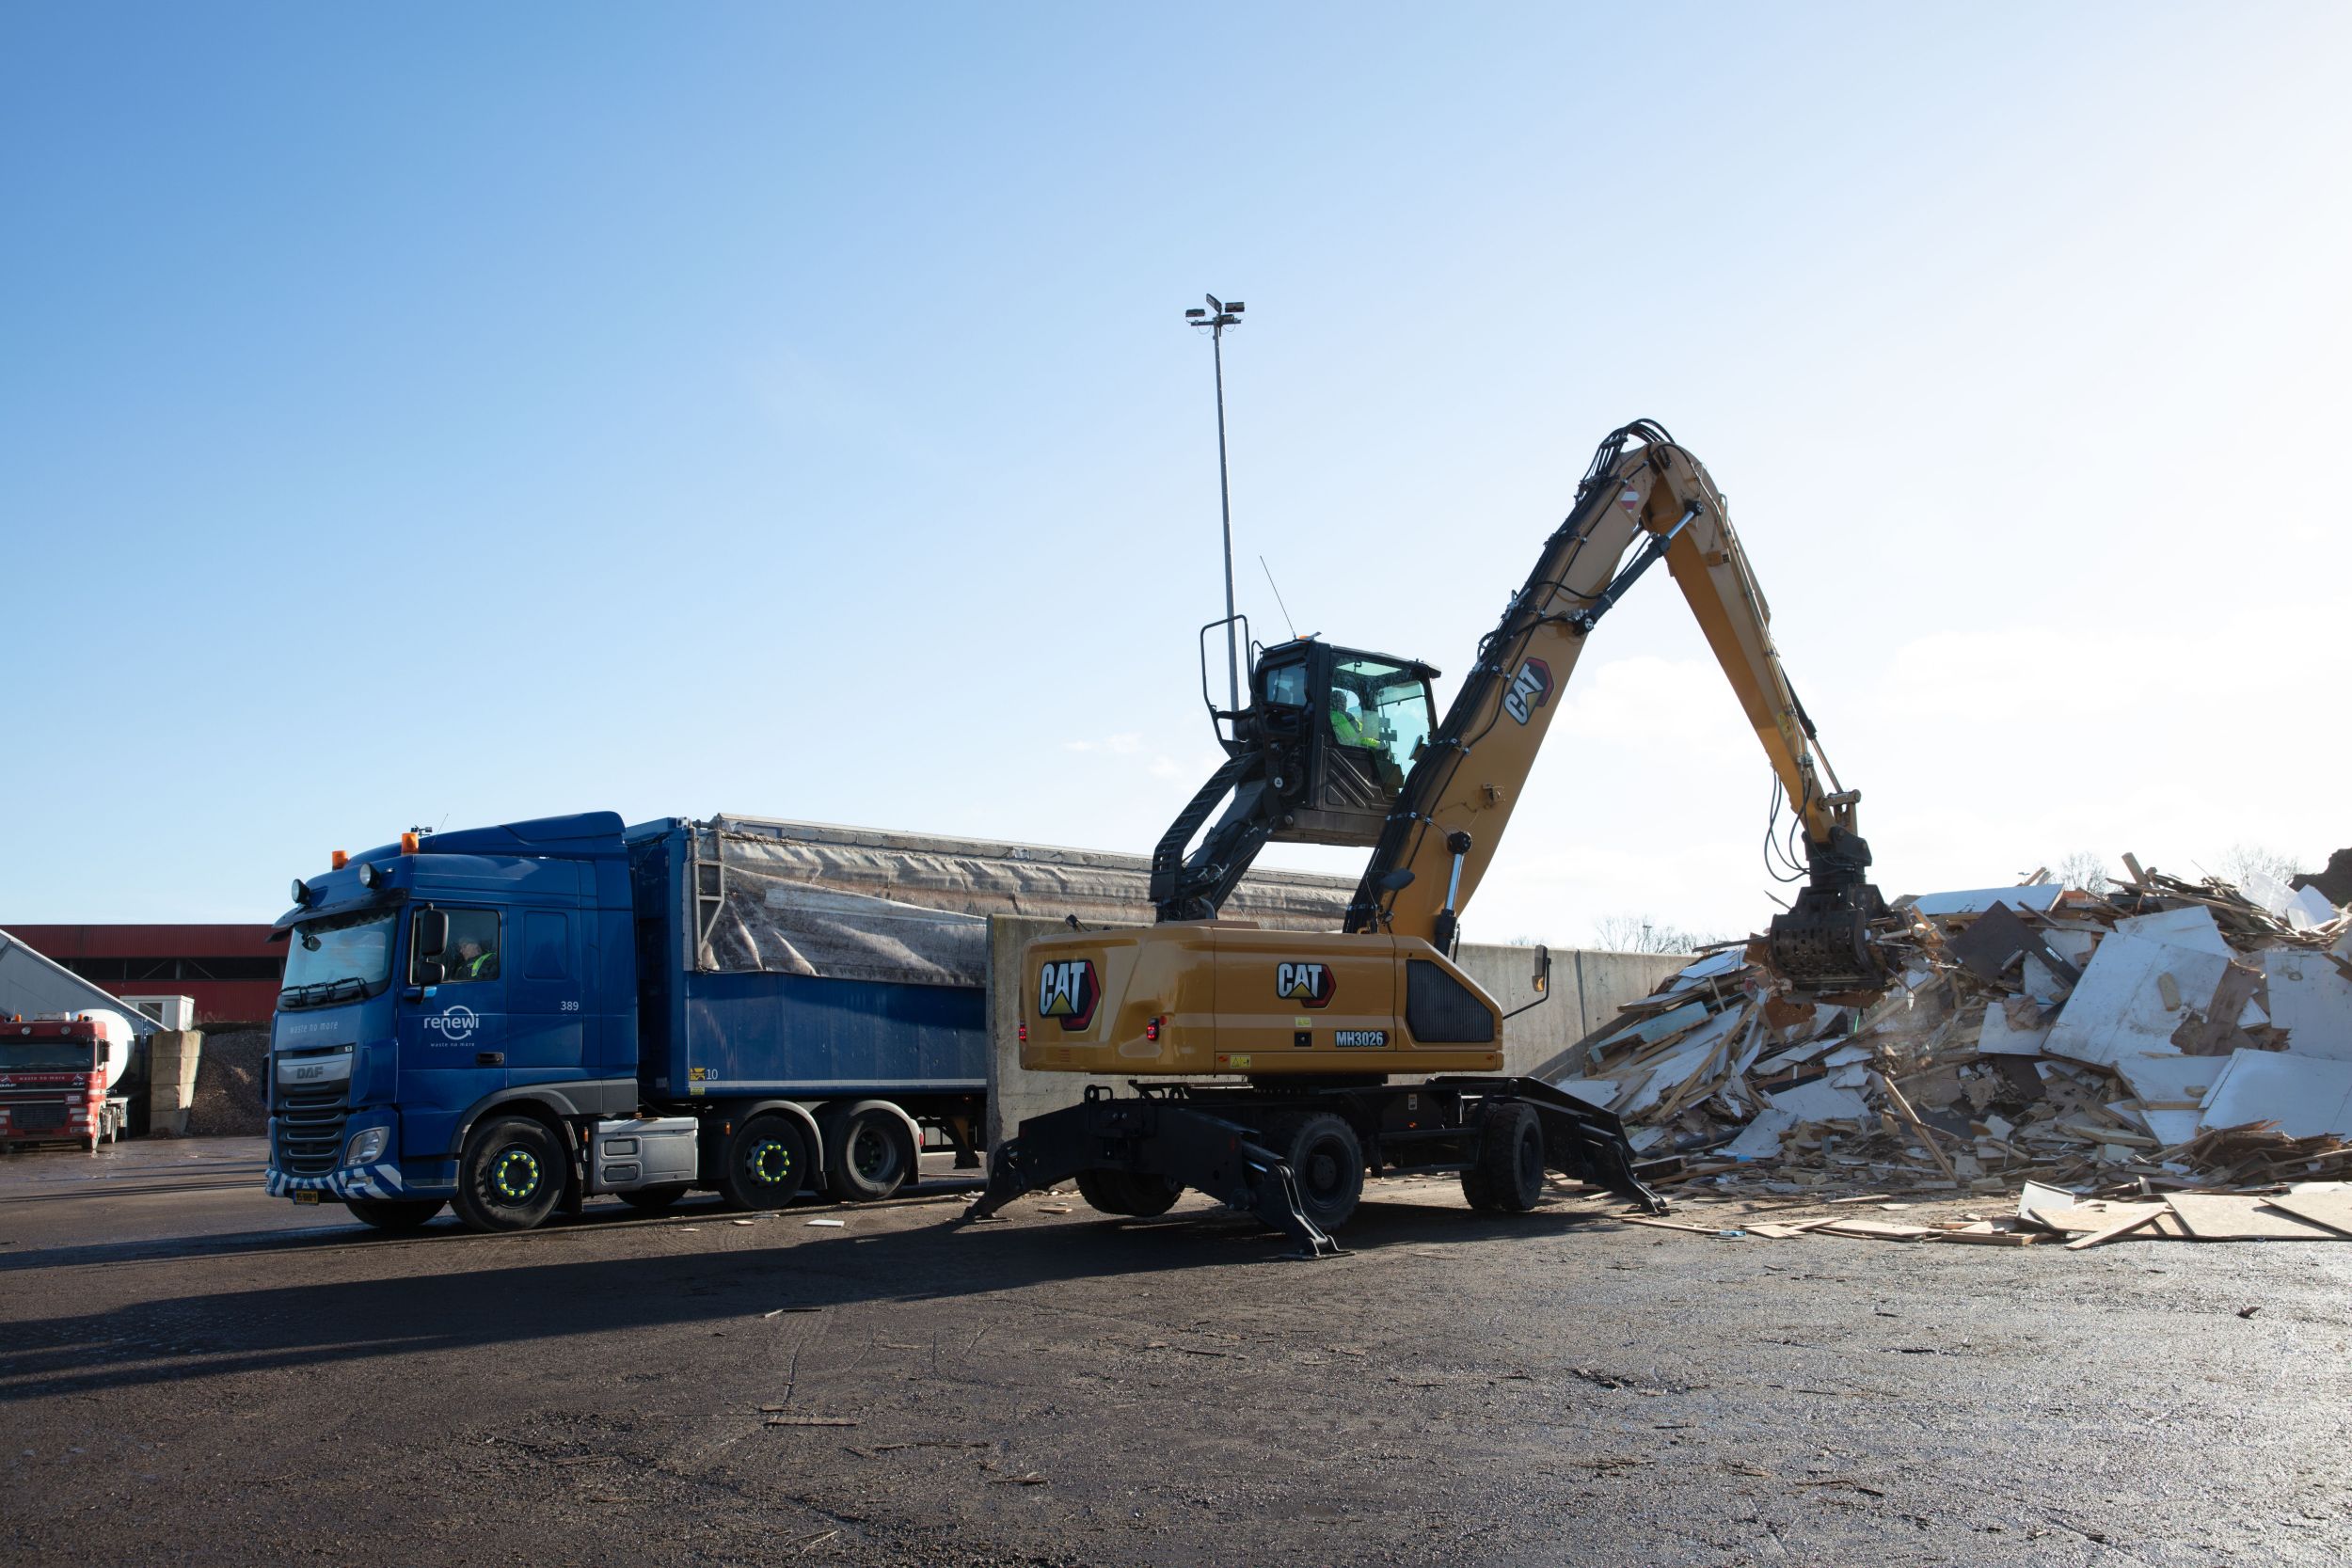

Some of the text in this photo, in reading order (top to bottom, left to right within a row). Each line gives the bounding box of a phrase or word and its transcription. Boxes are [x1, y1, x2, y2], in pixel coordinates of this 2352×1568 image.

[1504, 662, 1544, 723] CAT
[1040, 961, 1086, 1015] CAT
[1278, 963, 1322, 998] CAT
[560, 1001, 580, 1011] 389
[290, 1022, 339, 1034] waste no more
[423, 1013, 480, 1029] renewi
[1336, 1031, 1383, 1047] MH3026
[296, 1066, 324, 1079] DAF
[707, 1069, 719, 1080] 10
